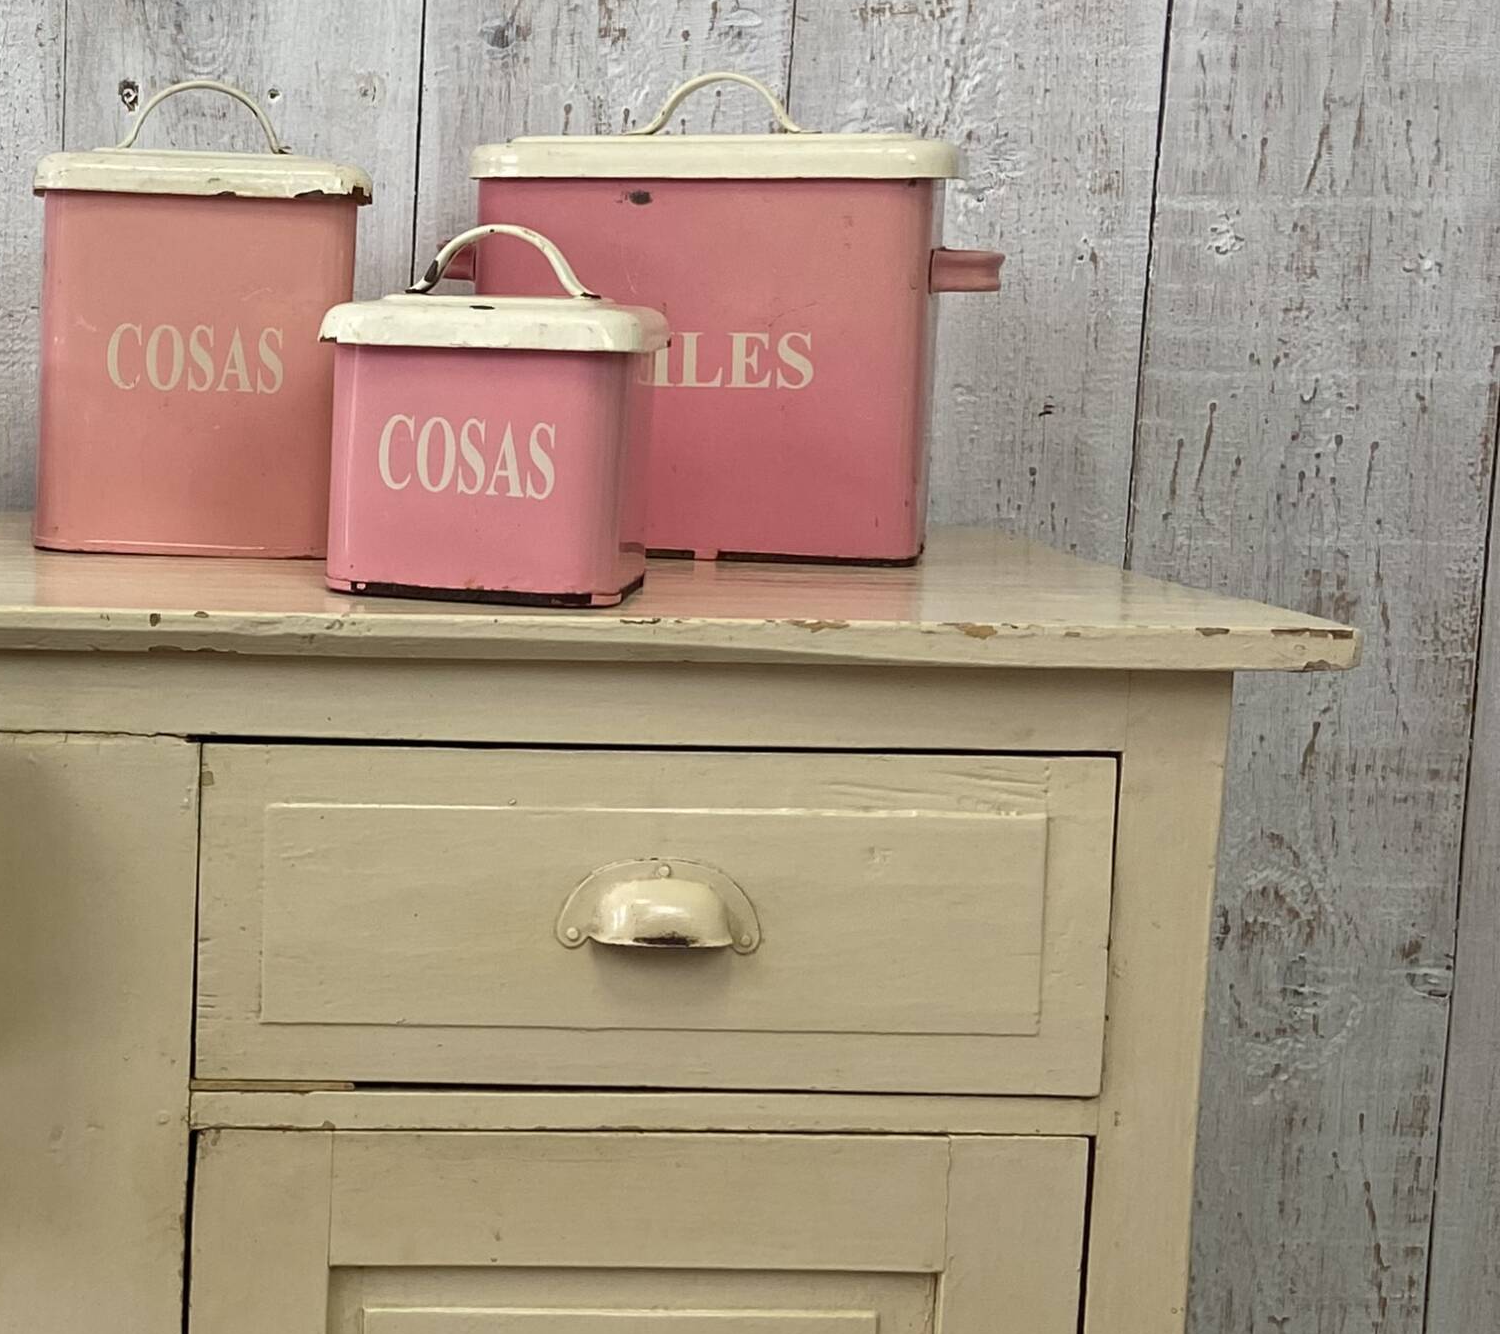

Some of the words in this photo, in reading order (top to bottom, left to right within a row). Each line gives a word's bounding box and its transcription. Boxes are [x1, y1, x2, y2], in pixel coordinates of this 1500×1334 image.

[106, 322, 285, 394] COSAS
[654, 331, 815, 390] ILES
[378, 414, 557, 500] COSAS
